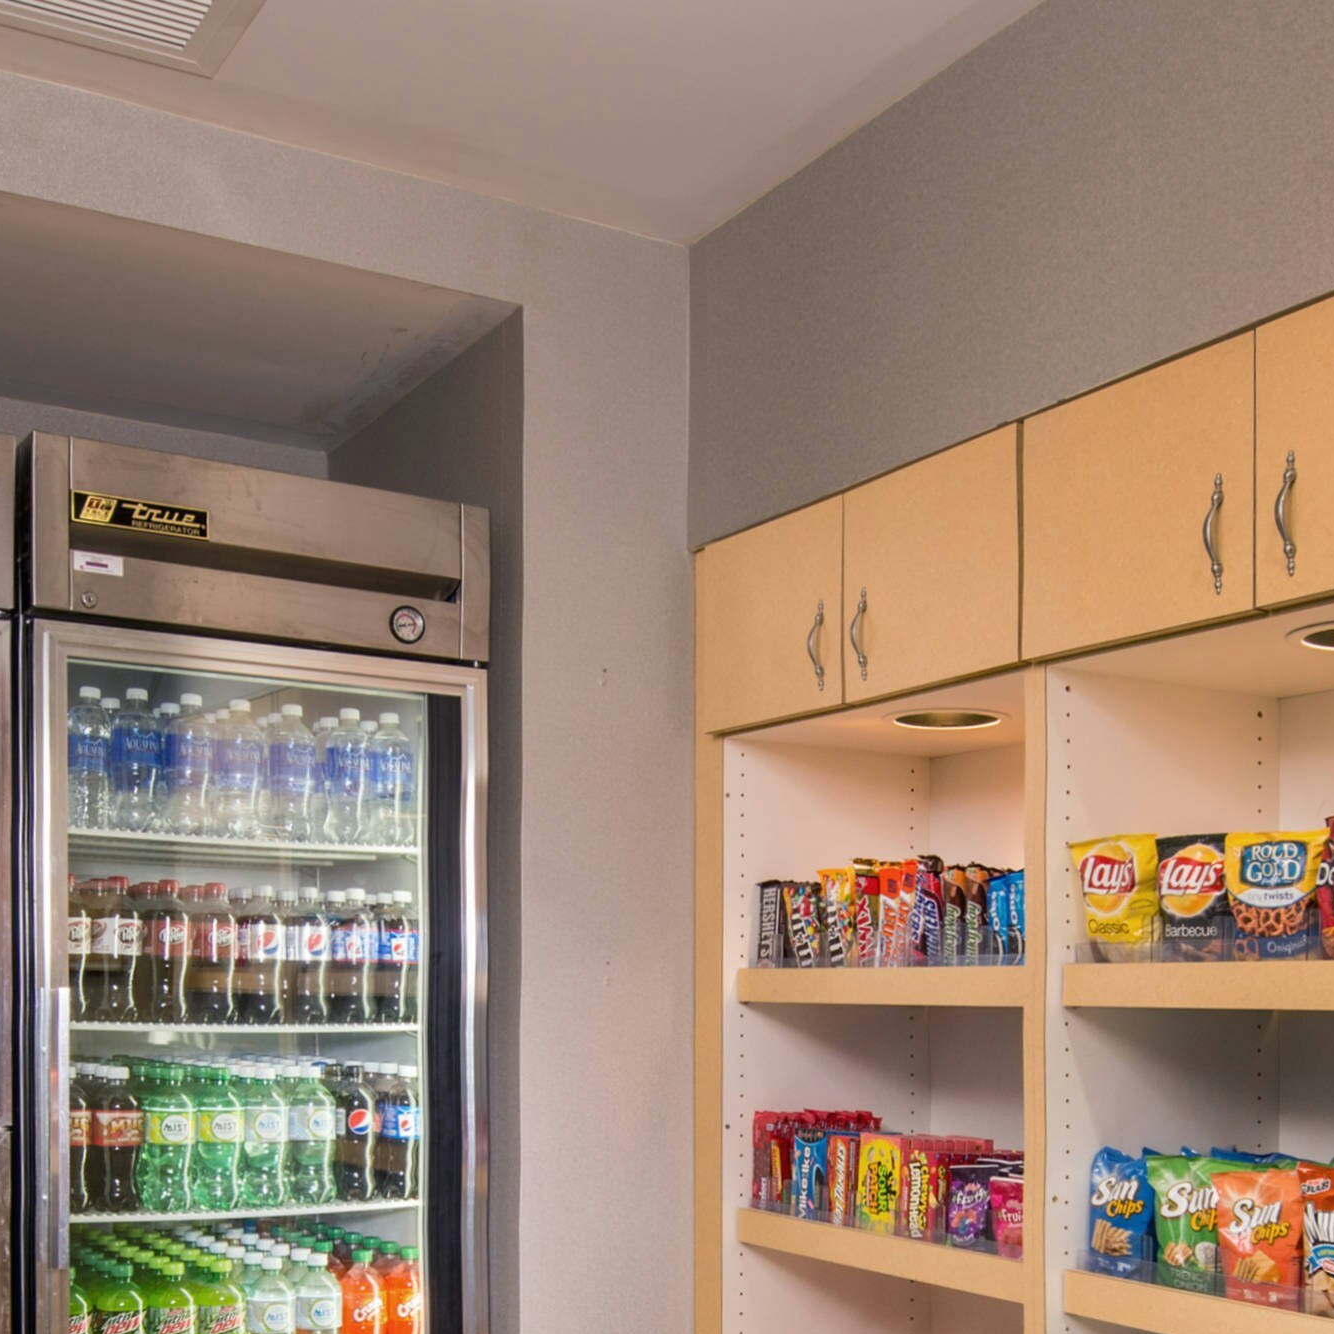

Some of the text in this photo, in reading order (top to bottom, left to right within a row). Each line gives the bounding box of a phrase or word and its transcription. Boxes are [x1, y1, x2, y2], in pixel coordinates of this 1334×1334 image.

[122, 503, 201, 528] true
[131, 520, 200, 537] REFRIGERATOR
[1251, 842, 1298, 861] ROLD
[1082, 858, 1136, 895] Lay's
[1160, 858, 1223, 895] Lay's
[1246, 859, 1301, 882] GOLD
[1088, 919, 1129, 935] Classic
[1166, 923, 1217, 938] Barbecue
[868, 1162, 879, 1215] PATCH
[877, 1165, 887, 1212] SOUR
[1092, 1176, 1140, 1206] Sun
[1161, 1181, 1220, 1218] Sun
[1107, 1199, 1144, 1219] Chips
[1229, 1198, 1282, 1234] Sun
[1251, 1221, 1290, 1245] Chips
